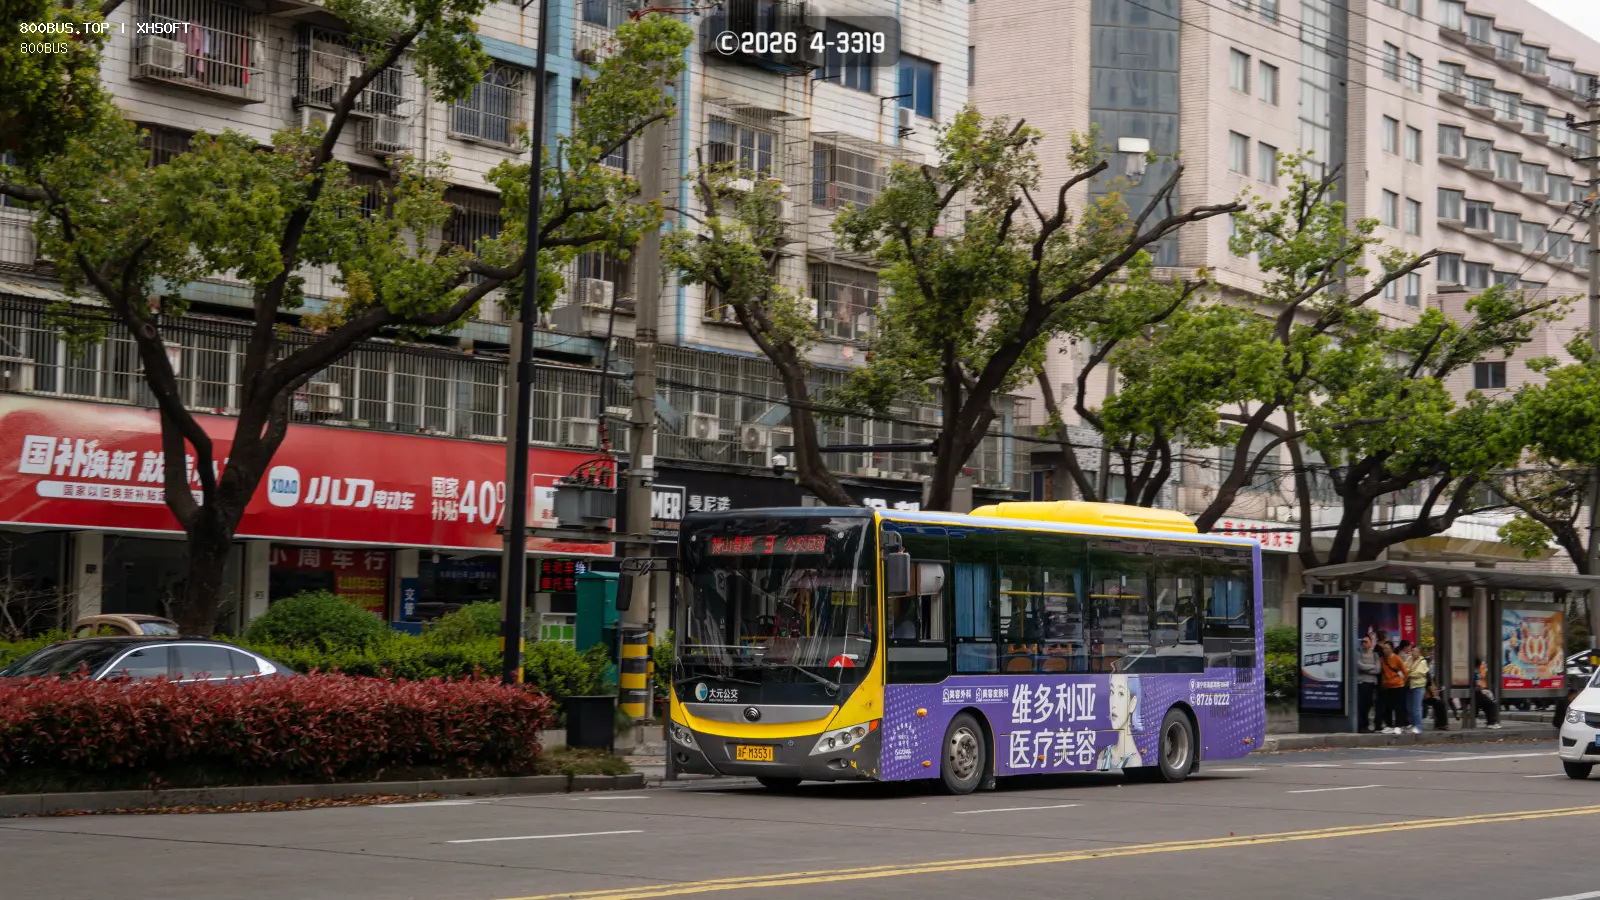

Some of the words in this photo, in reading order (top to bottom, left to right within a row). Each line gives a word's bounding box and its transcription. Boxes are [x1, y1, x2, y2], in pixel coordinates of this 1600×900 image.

[18, 434, 137, 481] 国补换新
[431, 477, 460, 499] 国家
[431, 500, 460, 522] 补贴
[763, 535, 775, 554] 3
[709, 688, 739, 699] 大元公交
[1012, 682, 1097, 724] 维多利亚
[1196, 693, 1213, 706] 8726
[1213, 693, 1230, 706] 0222
[1009, 727, 1096, 768] 医疗美容
